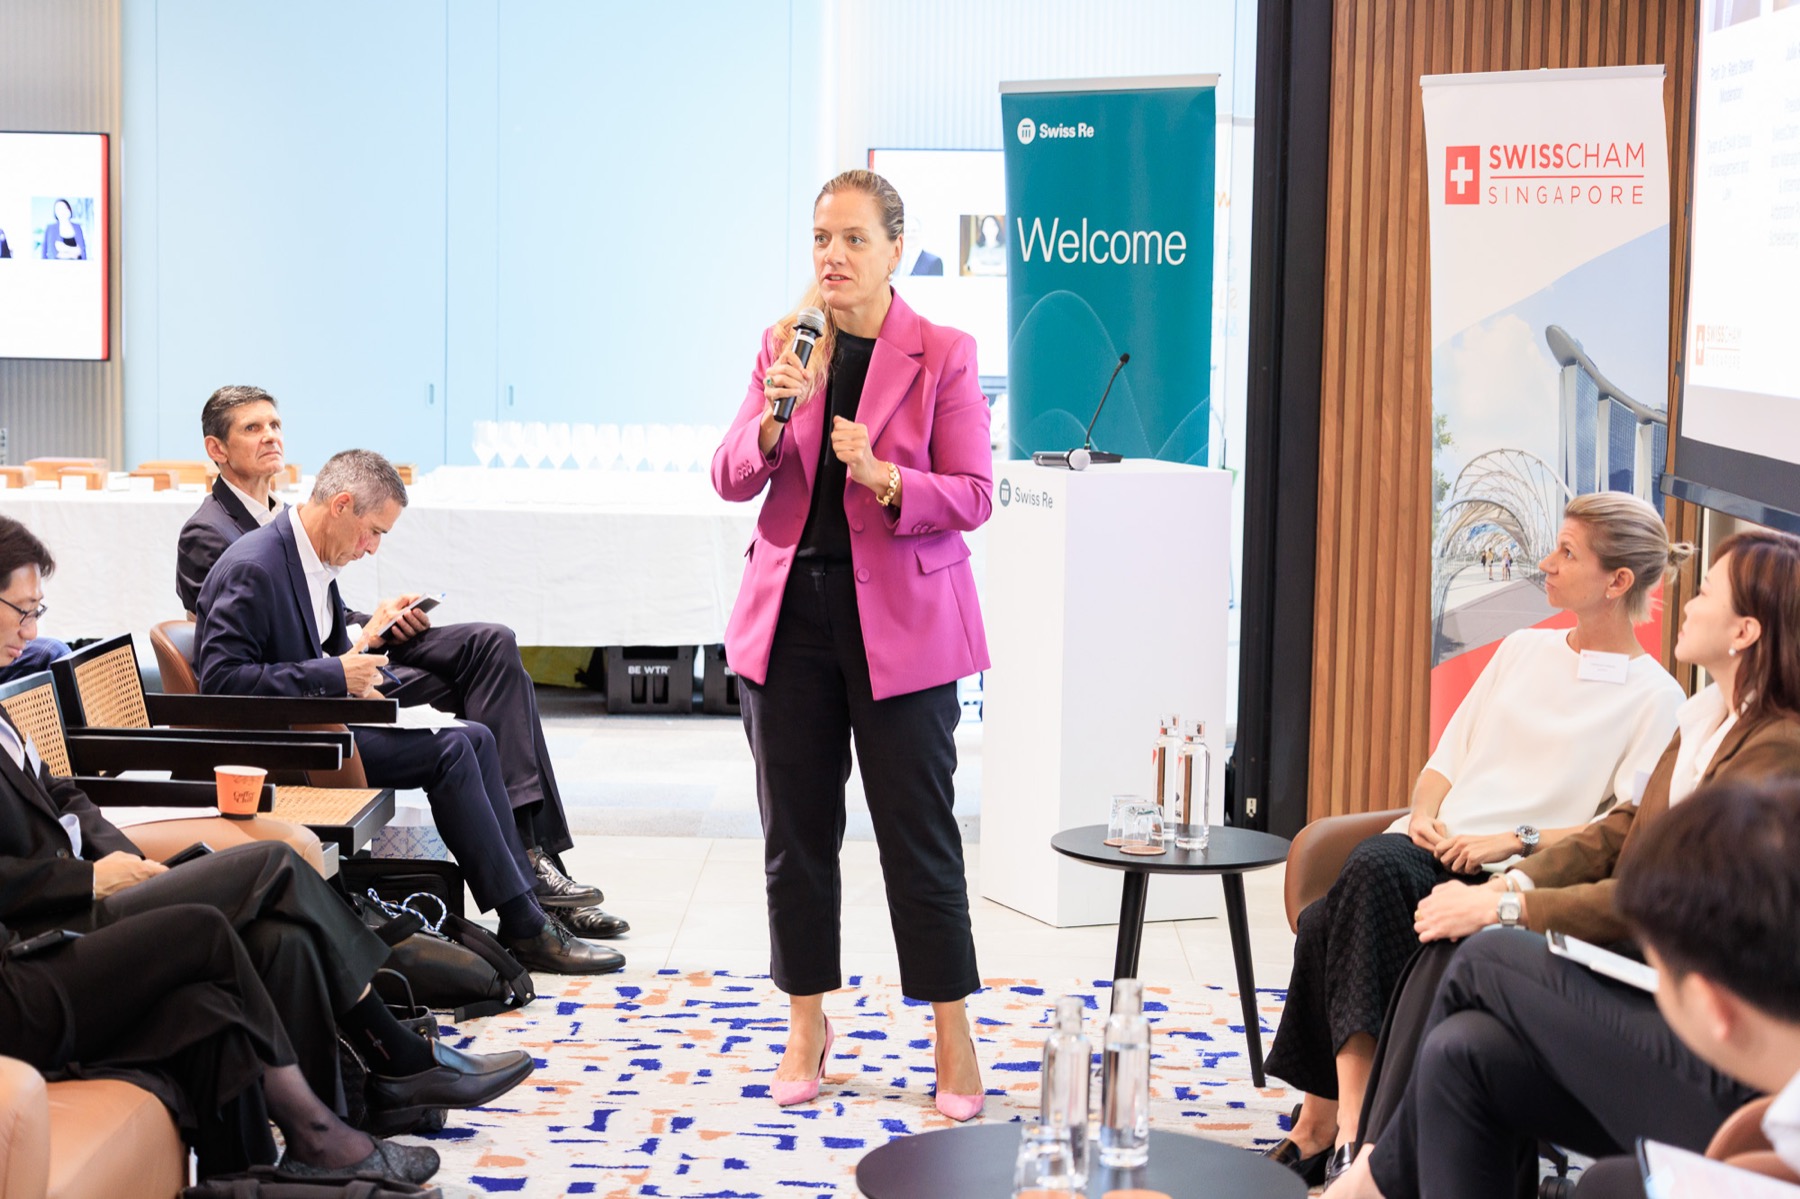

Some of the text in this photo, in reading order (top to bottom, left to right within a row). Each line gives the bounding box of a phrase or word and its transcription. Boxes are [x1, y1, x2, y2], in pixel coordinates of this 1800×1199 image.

[1039, 122, 1095, 139] Swiss Re
[1488, 142, 1645, 170] SWISSCHAM
[1488, 185, 1644, 205] SINGAPORE
[1016, 217, 1187, 266] Welcome
[1014, 487, 1053, 509] Swiss Re
[628, 665, 669, 675] BE WTR
